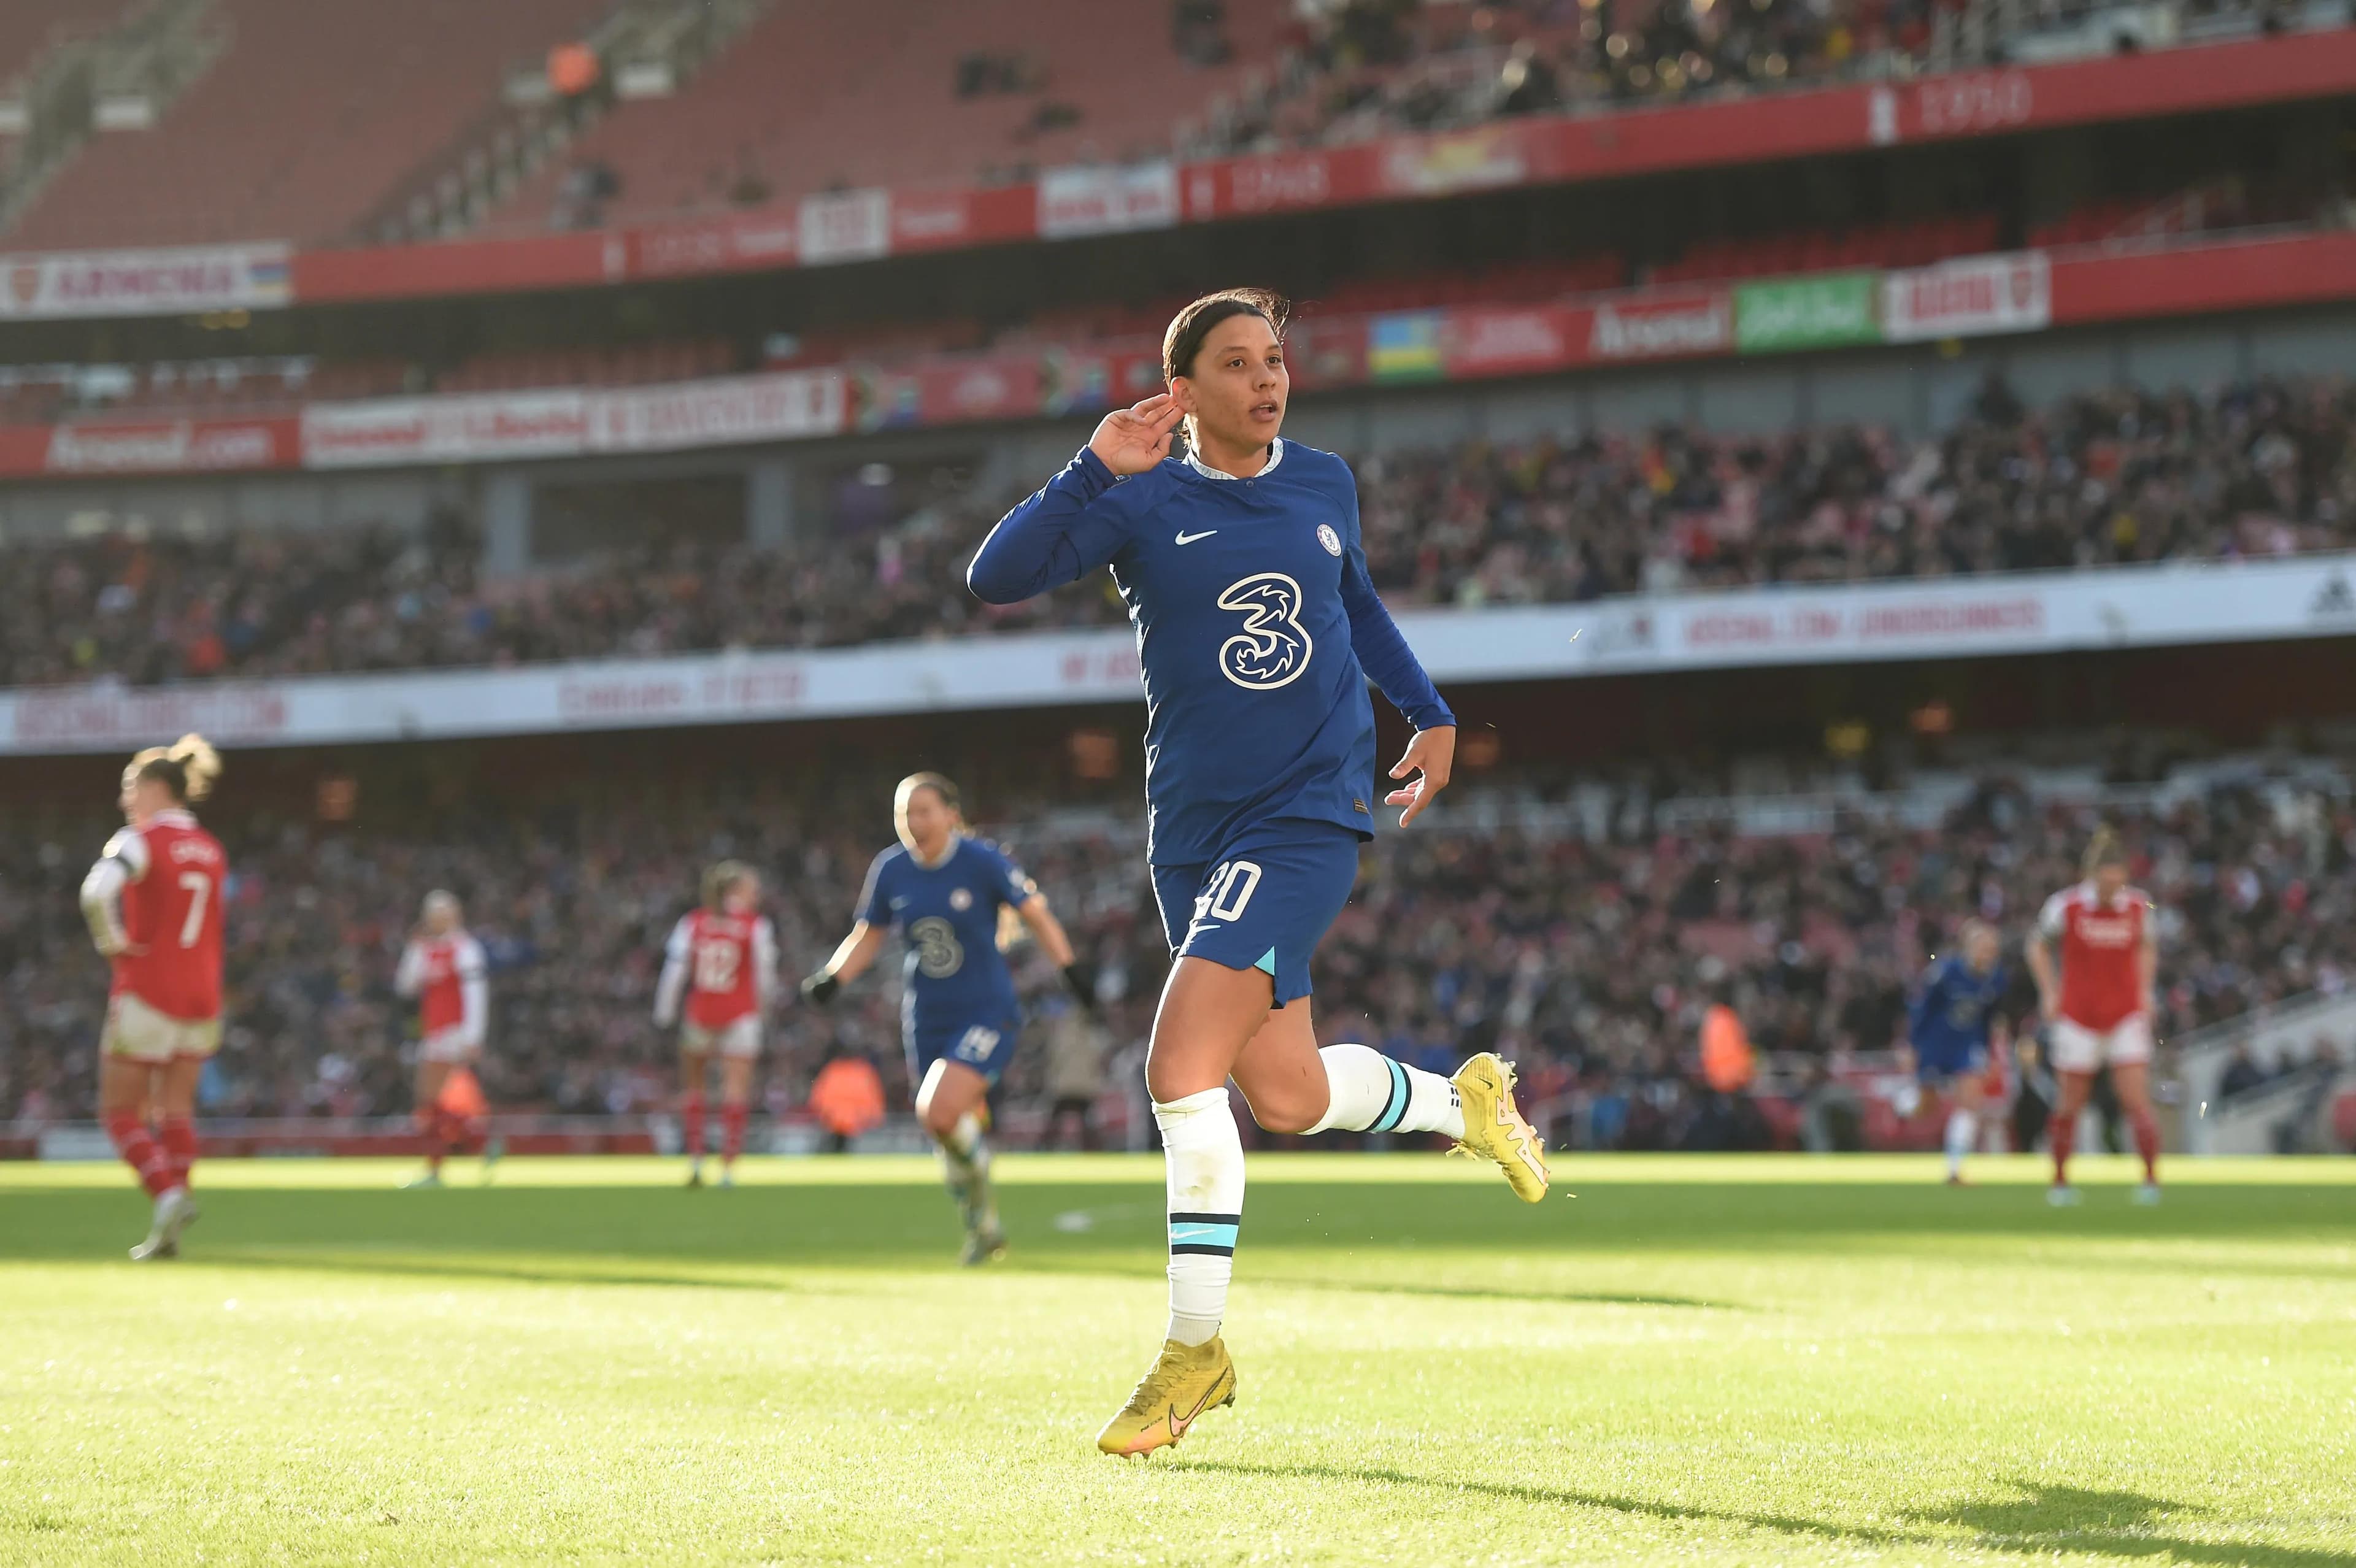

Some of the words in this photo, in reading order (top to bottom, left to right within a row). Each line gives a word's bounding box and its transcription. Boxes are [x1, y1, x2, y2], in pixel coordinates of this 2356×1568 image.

[1217, 572, 1313, 690] 3
[179, 871, 211, 949] 7
[695, 938, 742, 994] 12
[909, 915, 964, 979] 3
